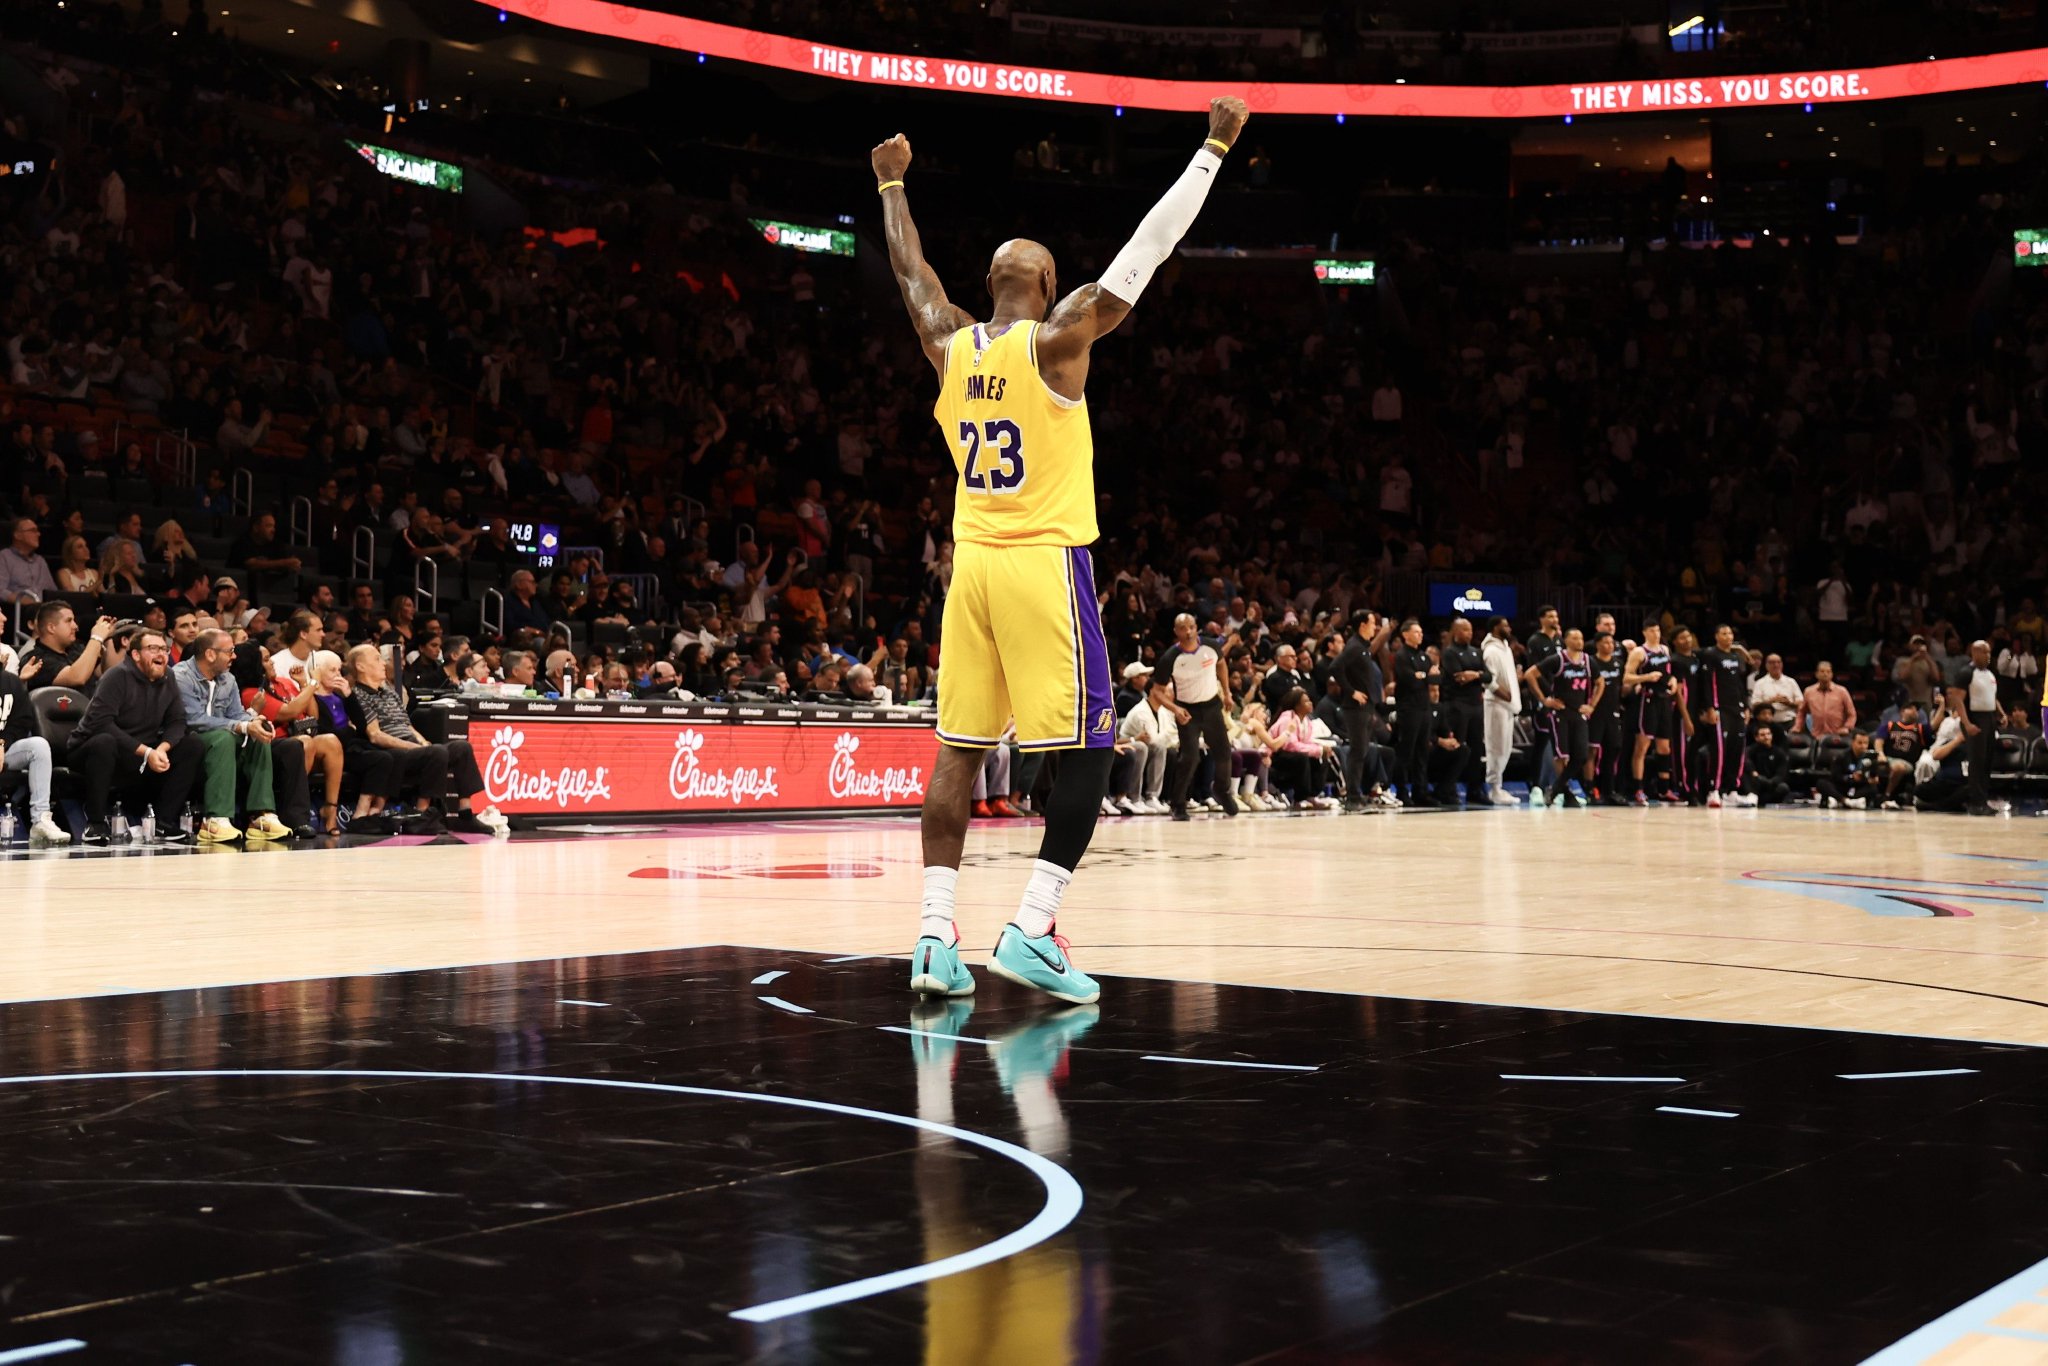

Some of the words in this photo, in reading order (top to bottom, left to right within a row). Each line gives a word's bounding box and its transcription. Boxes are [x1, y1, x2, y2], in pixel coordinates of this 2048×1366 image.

[811, 46, 862, 76] THEY
[871, 56, 935, 84] MISS.
[943, 63, 988, 88] YOU
[995, 68, 1073, 96] SCORE.
[1570, 85, 1632, 110] THEY
[1642, 81, 1712, 107] MISS.
[1720, 78, 1770, 102] YOU
[1779, 74, 1869, 100] SCORE.
[959, 417, 1028, 496] 23
[510, 524, 533, 541] 14.8
[479, 701, 510, 710] ticketmaster
[528, 703, 557, 711] ticketmaster
[484, 742, 611, 808] Chick-fil-A
[669, 744, 779, 805] Chick-fil-A
[829, 746, 923, 802] Chick-fil-A
